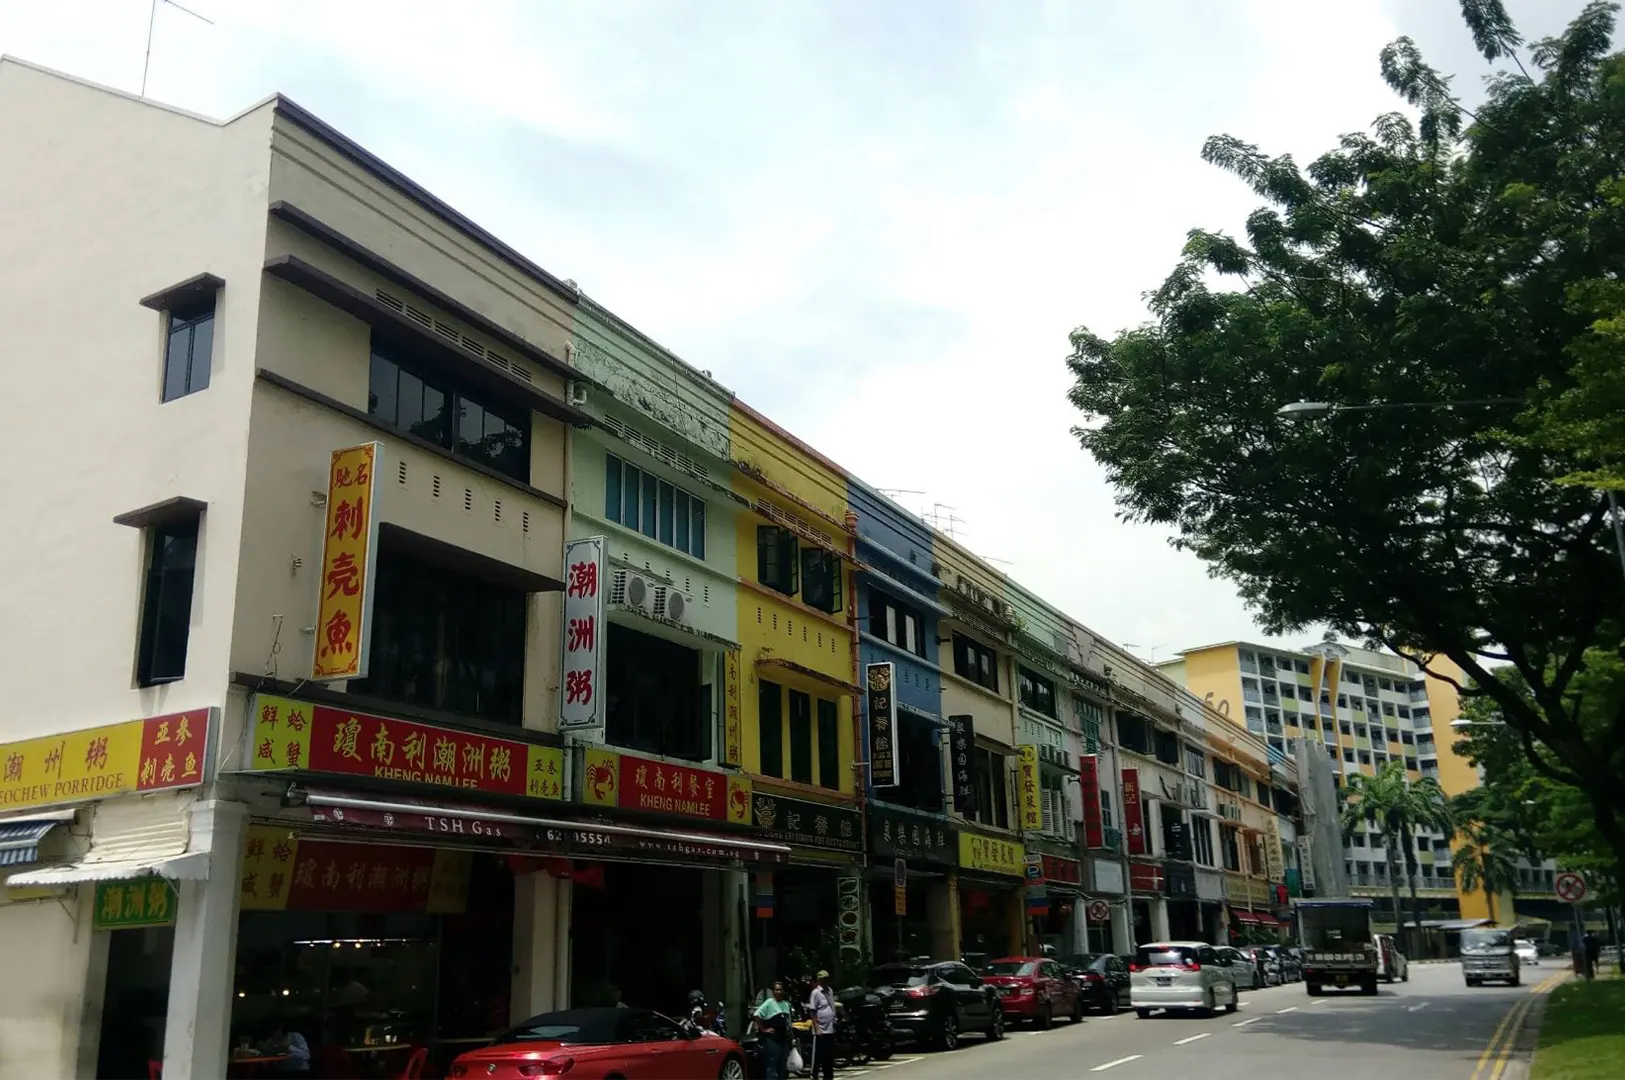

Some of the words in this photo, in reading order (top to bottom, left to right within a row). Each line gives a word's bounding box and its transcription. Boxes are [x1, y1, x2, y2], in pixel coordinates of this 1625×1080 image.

[566, 560, 597, 706] 潮洲粥
[3, 736, 109, 782] 潮州粥
[54, 772, 125, 796] PORRIDGE
[374, 766, 421, 783] KHENG
[640, 792, 672, 811] KHENG
[424, 816, 463, 834] TSH
[472, 821, 501, 837] Gas
